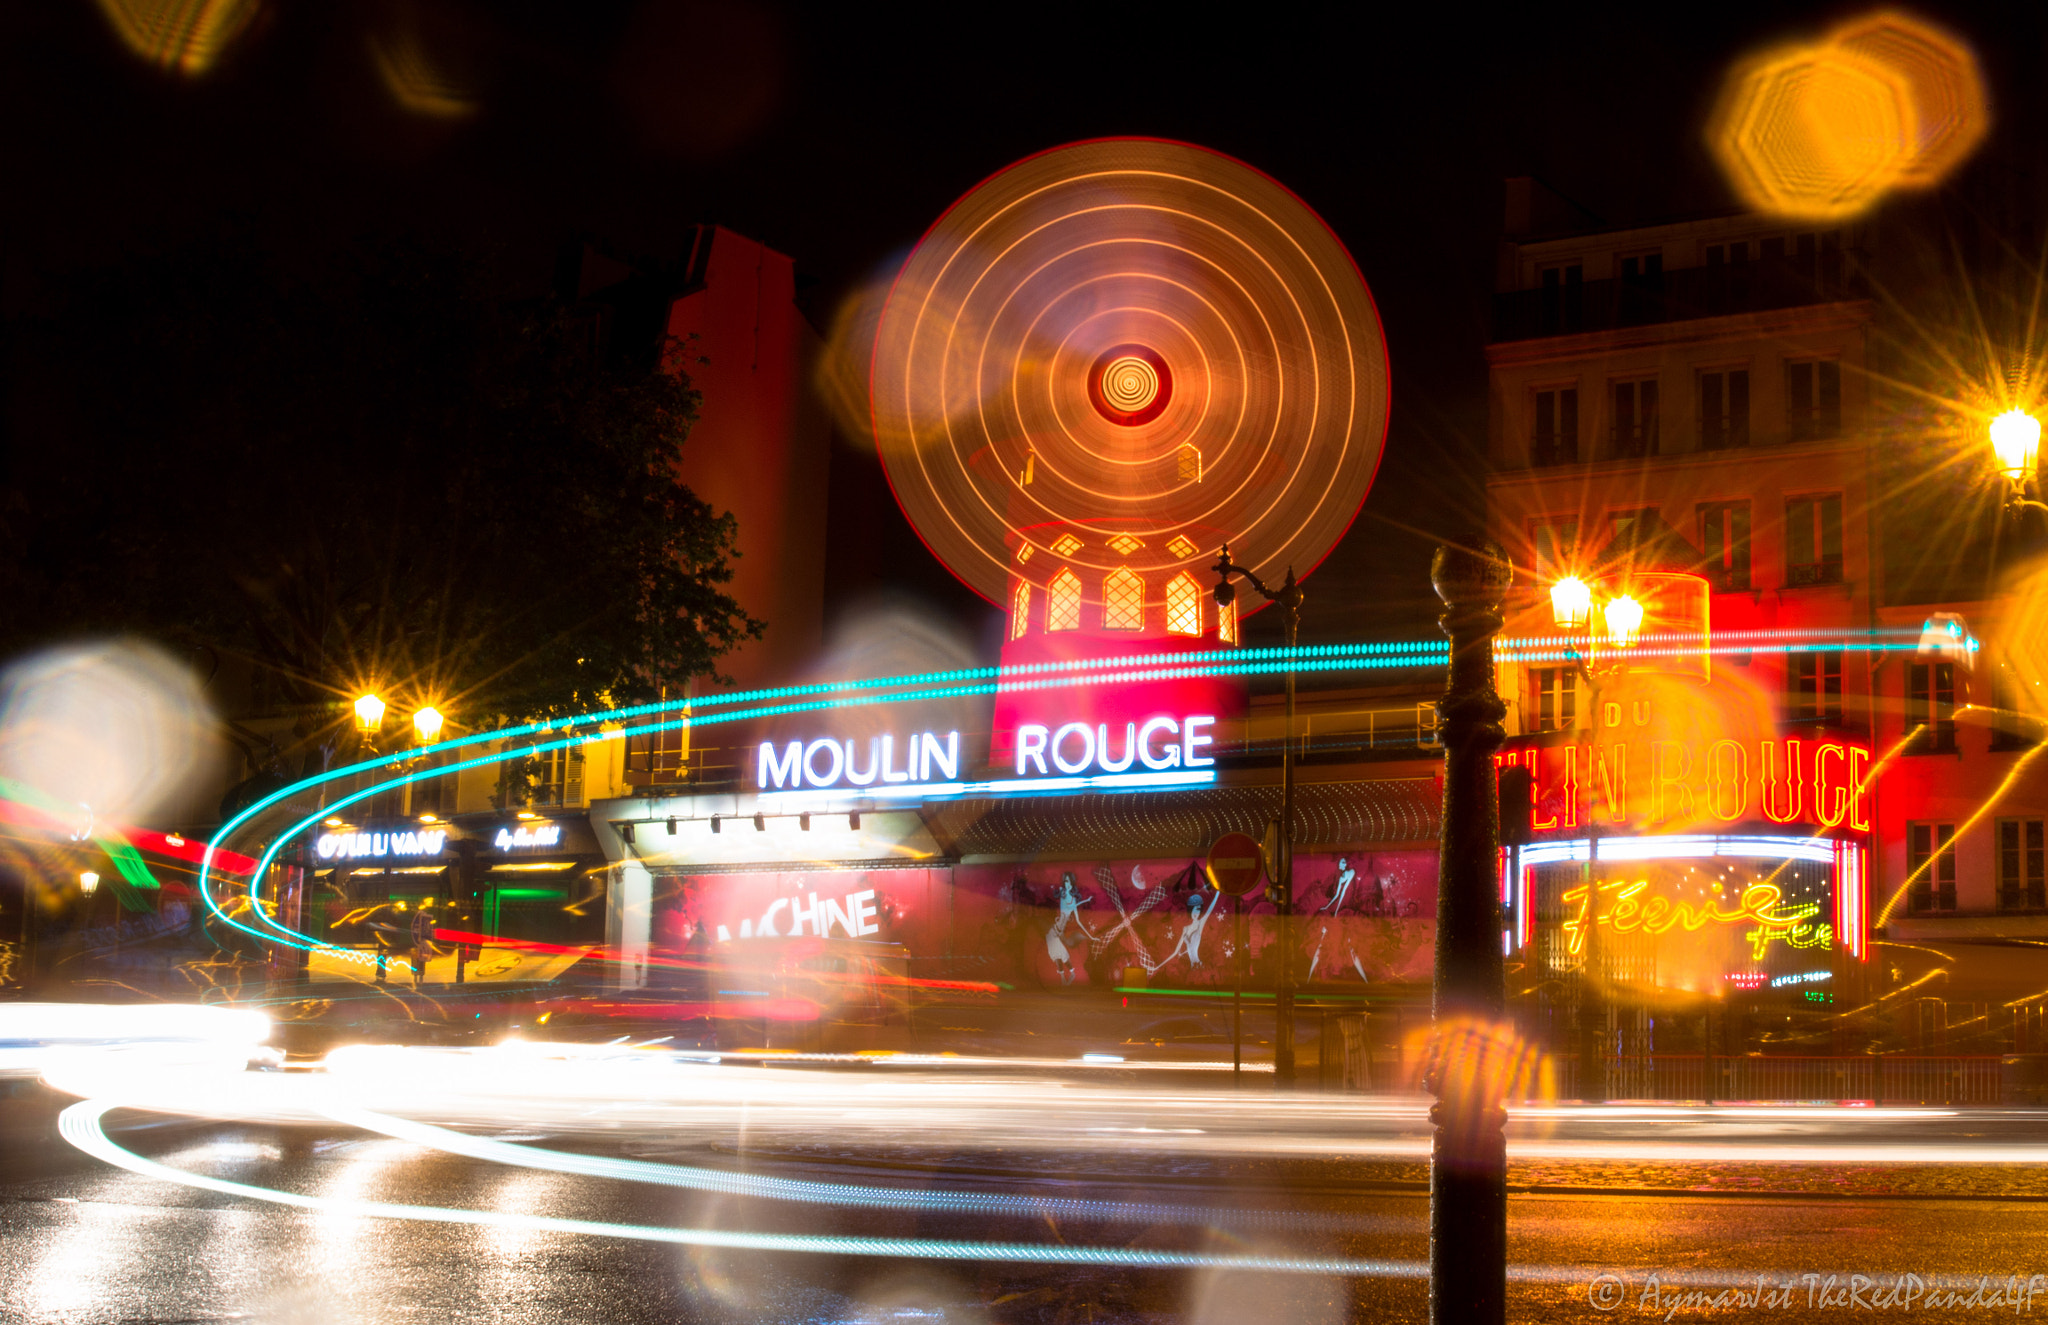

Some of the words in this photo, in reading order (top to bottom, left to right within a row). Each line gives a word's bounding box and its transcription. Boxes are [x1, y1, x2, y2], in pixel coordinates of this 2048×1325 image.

[1604, 701, 1650, 728] DU
[758, 730, 960, 788] MOULIN
[1016, 716, 1216, 775] ROUGE
[1495, 743, 1627, 830] LIN
[1650, 739, 1870, 832] ROUGE
